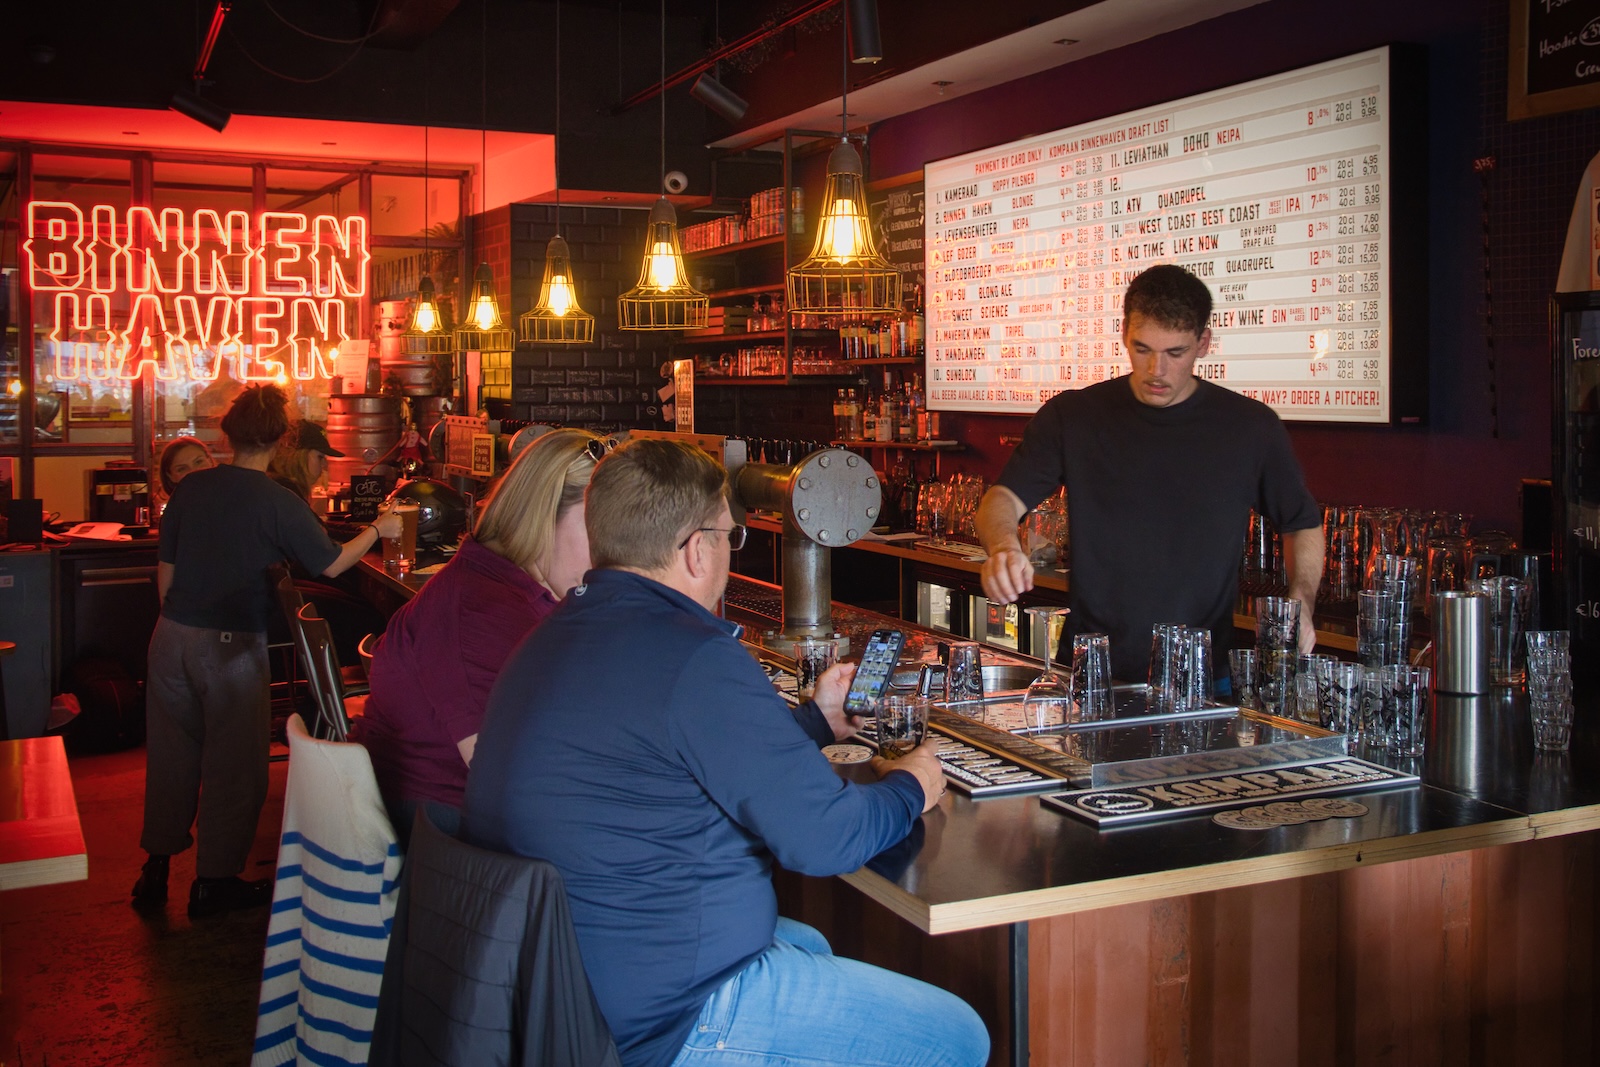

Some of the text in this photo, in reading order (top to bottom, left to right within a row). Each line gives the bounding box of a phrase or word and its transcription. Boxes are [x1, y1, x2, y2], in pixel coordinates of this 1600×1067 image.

[1540, 32, 1577, 58] Hoodie
[1336, 96, 1376, 112] 20 cl 5,10
[1336, 106, 1376, 121] 40 cl 9,95
[976, 119, 1168, 174] PAYMENT BY CARD ONLY KOMPAAN BINNENHAVEN DRAFT LIST
[1111, 128, 1240, 168] 11. LEVIATHAN NEIPA
[1338, 155, 1378, 169] 20 cl 4,95
[1338, 165, 1377, 179] 40 cl 9,70
[945, 184, 977, 202] KAMERAAD
[993, 179, 1009, 192] HOPPY
[1012, 173, 1035, 187] PILSNER
[1110, 177, 1120, 192] 12.
[1339, 184, 1379, 197] 20 cl 5,10
[1111, 187, 1206, 215] 13. ATV QUADRUPEL
[1286, 197, 1300, 212] IPA
[1339, 194, 1379, 206] 40 cl 9,95
[944, 208, 965, 222] BINNEN
[972, 203, 992, 217] HAVEN
[1012, 195, 1033, 208] BLONDE
[1111, 224, 1122, 238] 14.
[1139, 218, 1161, 234] WEST
[1168, 214, 1196, 231] COAST
[1202, 209, 1224, 226] BEST
[1230, 204, 1260, 223] COAST
[1339, 214, 1379, 225] 20 cl 7,60
[945, 217, 1028, 242] LEVENSGENIETER NEIPA
[1241, 225, 1276, 237] DRY HOPPED
[1338, 224, 1379, 234] 40 cl 14,90
[1111, 234, 1219, 262] 15. NO TIME LIKE NOW
[1243, 236, 1274, 248] GRAPE ALE
[1338, 243, 1378, 254] 20 cl 7,65
[23, 201, 371, 298] BINNEN
[958, 246, 976, 260] GOZER
[1226, 257, 1273, 273] QUADRUPEL
[1338, 253, 1378, 264] 40 cl 15,20
[1338, 272, 1378, 283] 20 cl 7,65
[946, 284, 1012, 300] YU-SU BLOND ALE
[1232, 283, 1248, 292] HEAVY
[1338, 283, 1378, 293] 40 cl 15,20
[952, 309, 972, 321] SWEET
[981, 305, 1008, 318] SCIENCE
[1337, 301, 1378, 312] 20 cl 7,65
[1208, 309, 1286, 328] ARLEY WINE GIN
[1337, 311, 1378, 321] 40 cl 15,20
[50, 293, 350, 380] HAVEN
[944, 326, 1024, 341] MAVERICK MONK TRIPEL
[1338, 330, 1378, 340] 20 cl 7,20
[1027, 346, 1036, 357] IPA
[1112, 342, 1122, 356] 19.
[1338, 340, 1378, 350] 40 cl 13,80
[1198, 364, 1225, 379] CIDER
[1338, 360, 1378, 369] 20 cl 4,90
[947, 369, 976, 380] SUNBLOCK
[1337, 370, 1378, 380] 40 cl 9,50
[932, 390, 940, 400] ALL
[942, 390, 956, 400] BEERS
[958, 390, 985, 400] AVAILABLE
[987, 390, 993, 400] AS
[1262, 391, 1287, 404] WAY?
[1291, 391, 1319, 405] ORDER
[1324, 391, 1330, 404] A
[1335, 391, 1379, 405] PITCHER!
[1138, 761, 1380, 801] KOMPAAN
